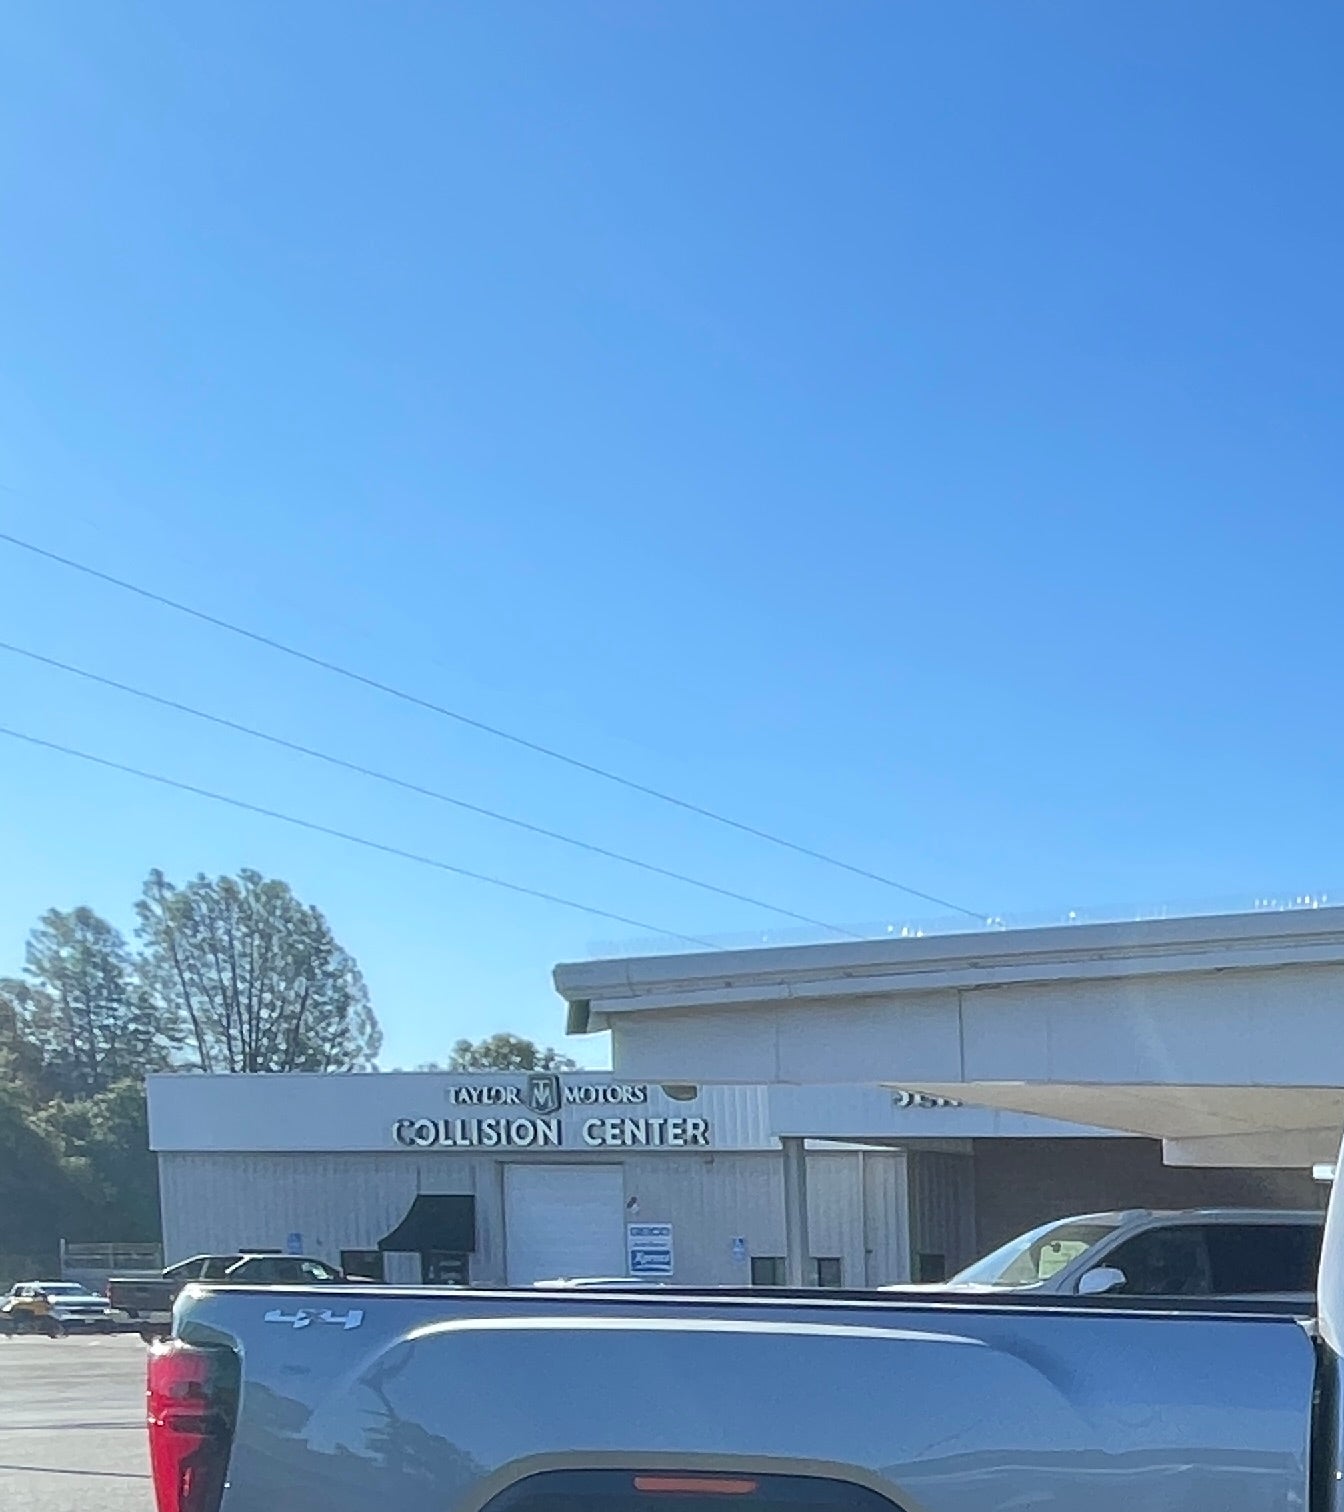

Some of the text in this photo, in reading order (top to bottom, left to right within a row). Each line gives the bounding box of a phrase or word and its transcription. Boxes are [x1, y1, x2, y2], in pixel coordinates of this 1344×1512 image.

[449, 1085, 521, 1104] TAYLOR
[563, 1085, 647, 1104] MOTORS
[392, 1118, 711, 1146] COLLISION CENTER
